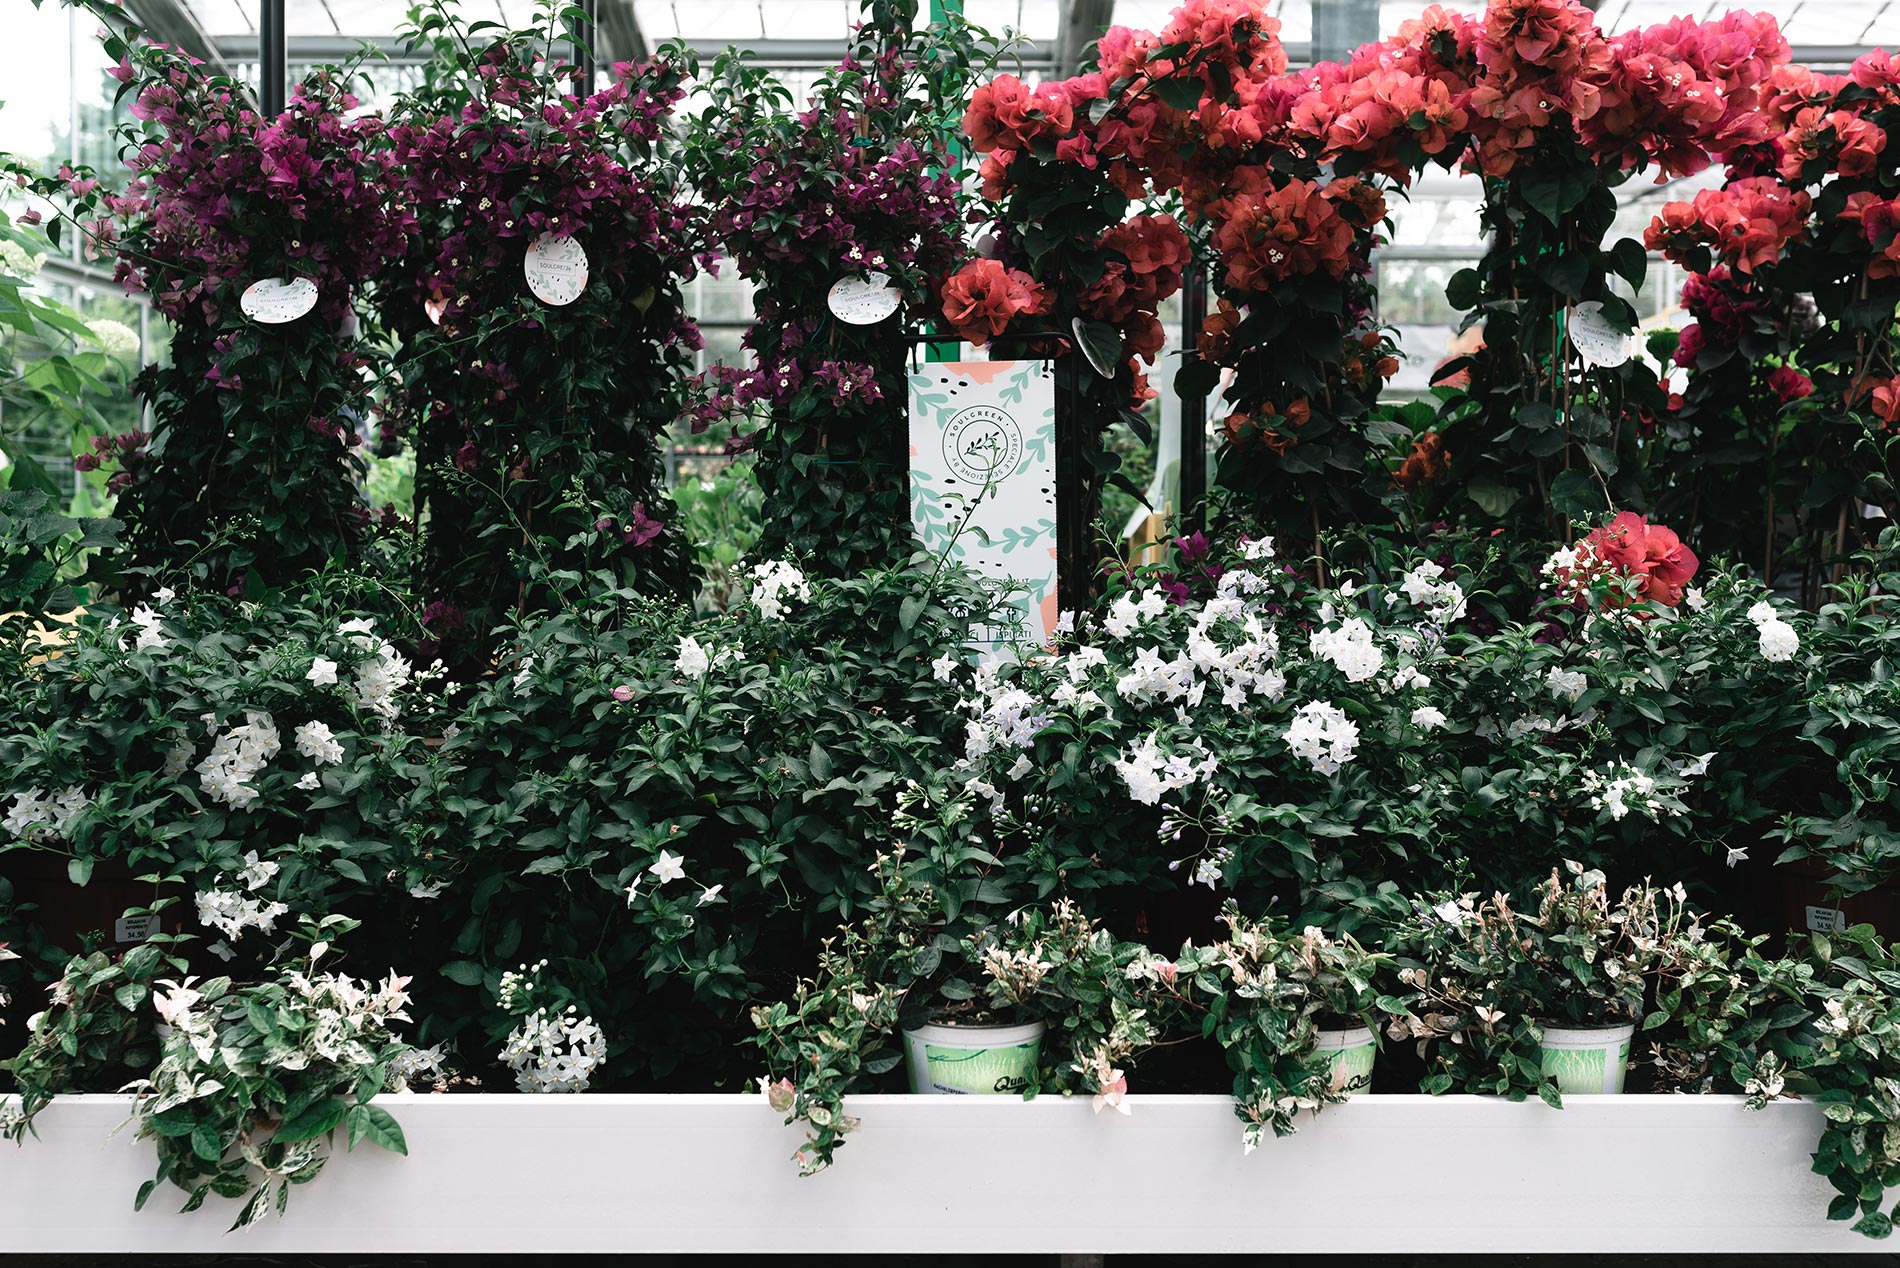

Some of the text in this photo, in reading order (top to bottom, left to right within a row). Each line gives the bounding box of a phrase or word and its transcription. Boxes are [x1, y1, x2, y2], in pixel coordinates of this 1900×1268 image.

[949, 410, 1004, 438] SOULGREEN
[951, 457, 961, 468] BY
[1001, 432, 1019, 470] SPECIALE
